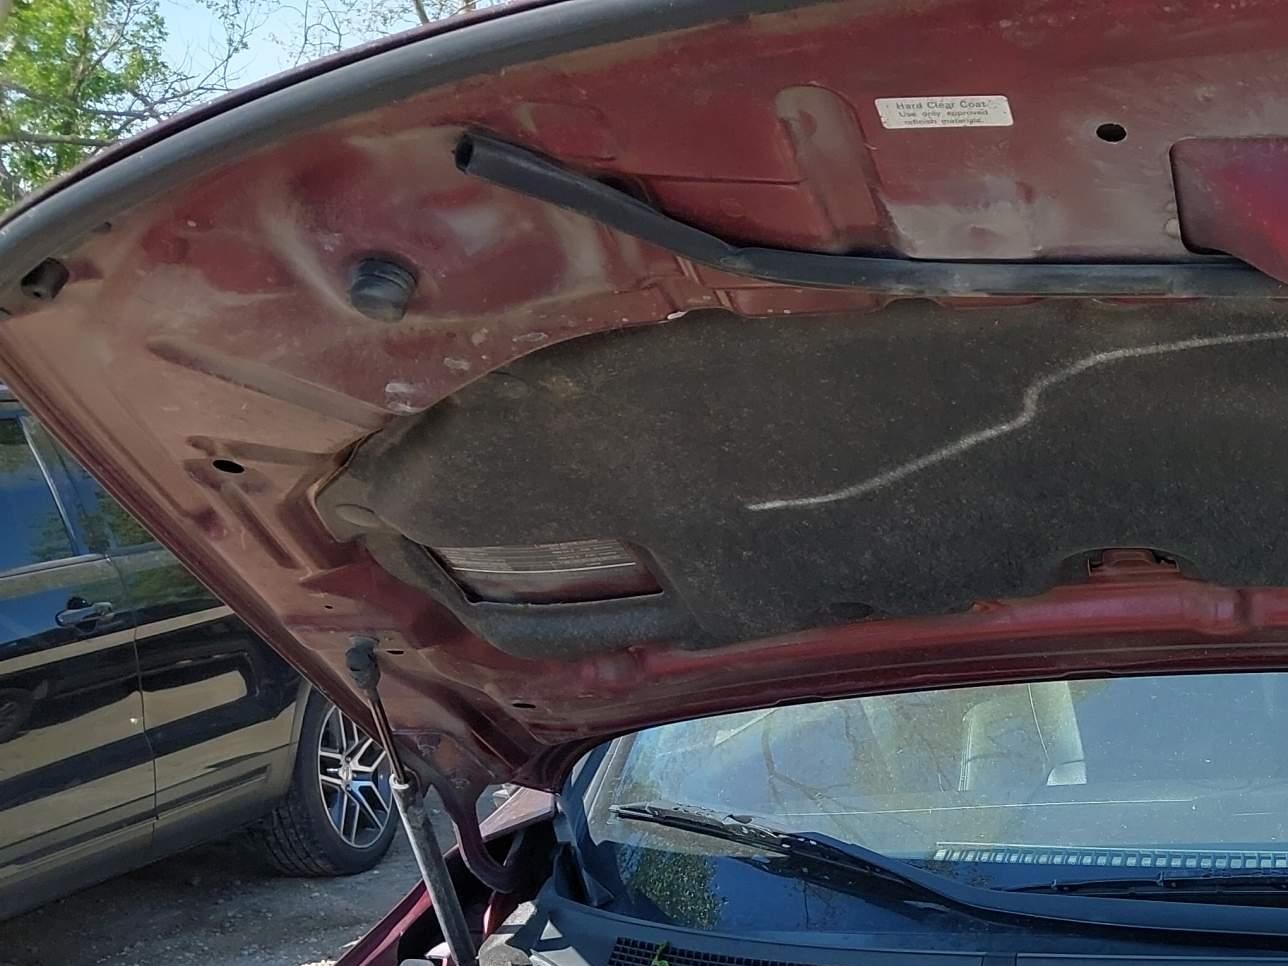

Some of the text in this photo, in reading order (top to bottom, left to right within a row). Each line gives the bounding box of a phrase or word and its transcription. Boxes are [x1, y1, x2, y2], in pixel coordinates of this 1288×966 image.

[896, 100, 987, 110] Hard Clear Coat
[922, 111, 941, 119] only
[946, 110, 989, 118] approved
